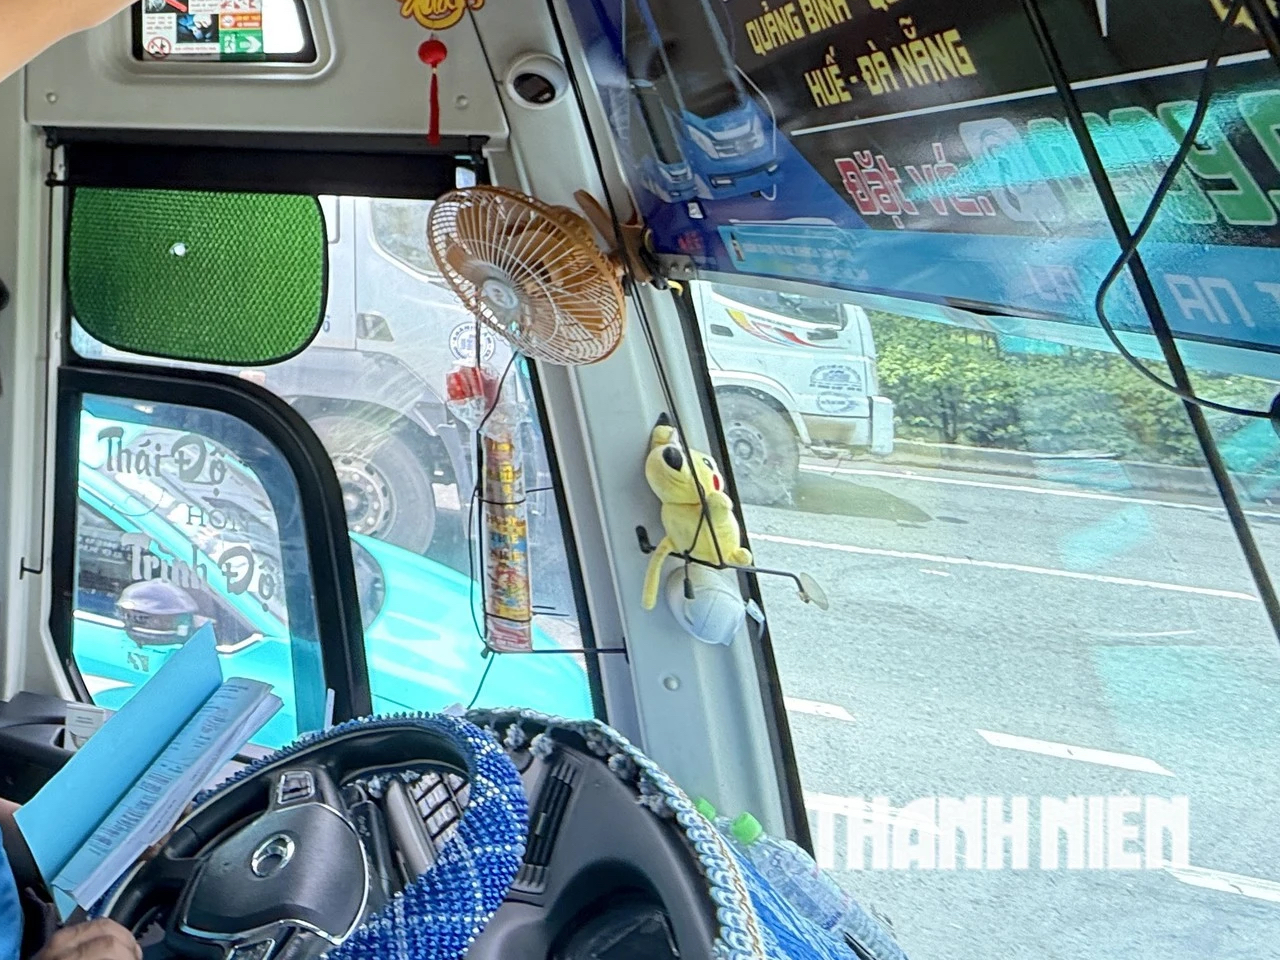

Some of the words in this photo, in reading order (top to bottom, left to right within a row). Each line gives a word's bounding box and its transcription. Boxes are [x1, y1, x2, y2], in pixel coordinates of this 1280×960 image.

[745, 0, 805, 57] QUẢNG
[804, 45, 853, 108] HUẾ
[856, 40, 901, 96] ĐÀ
[892, 16, 978, 88] NẴNG
[834, 149, 920, 230] Đặt
